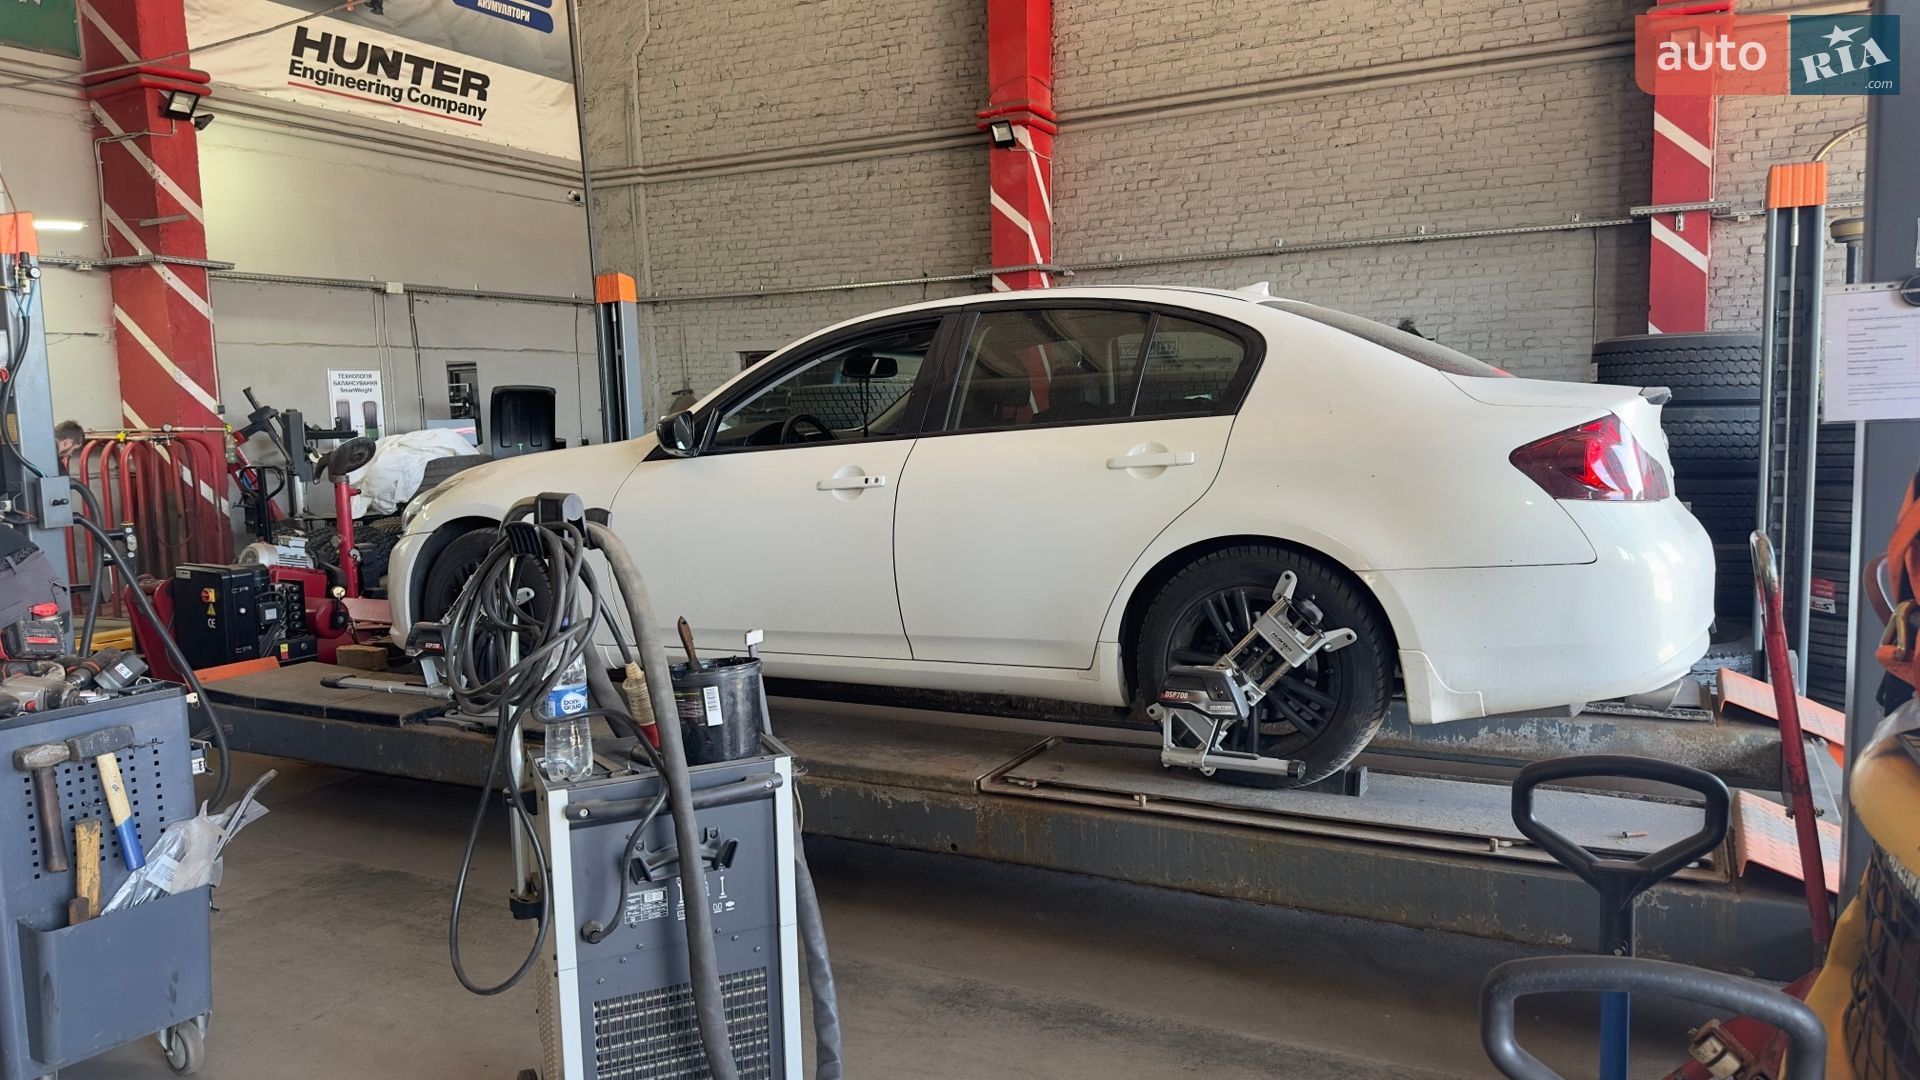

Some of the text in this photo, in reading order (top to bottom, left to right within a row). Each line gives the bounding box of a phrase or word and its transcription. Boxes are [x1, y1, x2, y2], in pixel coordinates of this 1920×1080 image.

[477, 0, 531, 22] АКУМУЛЯТОРИ
[291, 25, 491, 102] HUNTER
[288, 59, 487, 121] Engineering Company
[1165, 690, 1189, 699] DSP700
